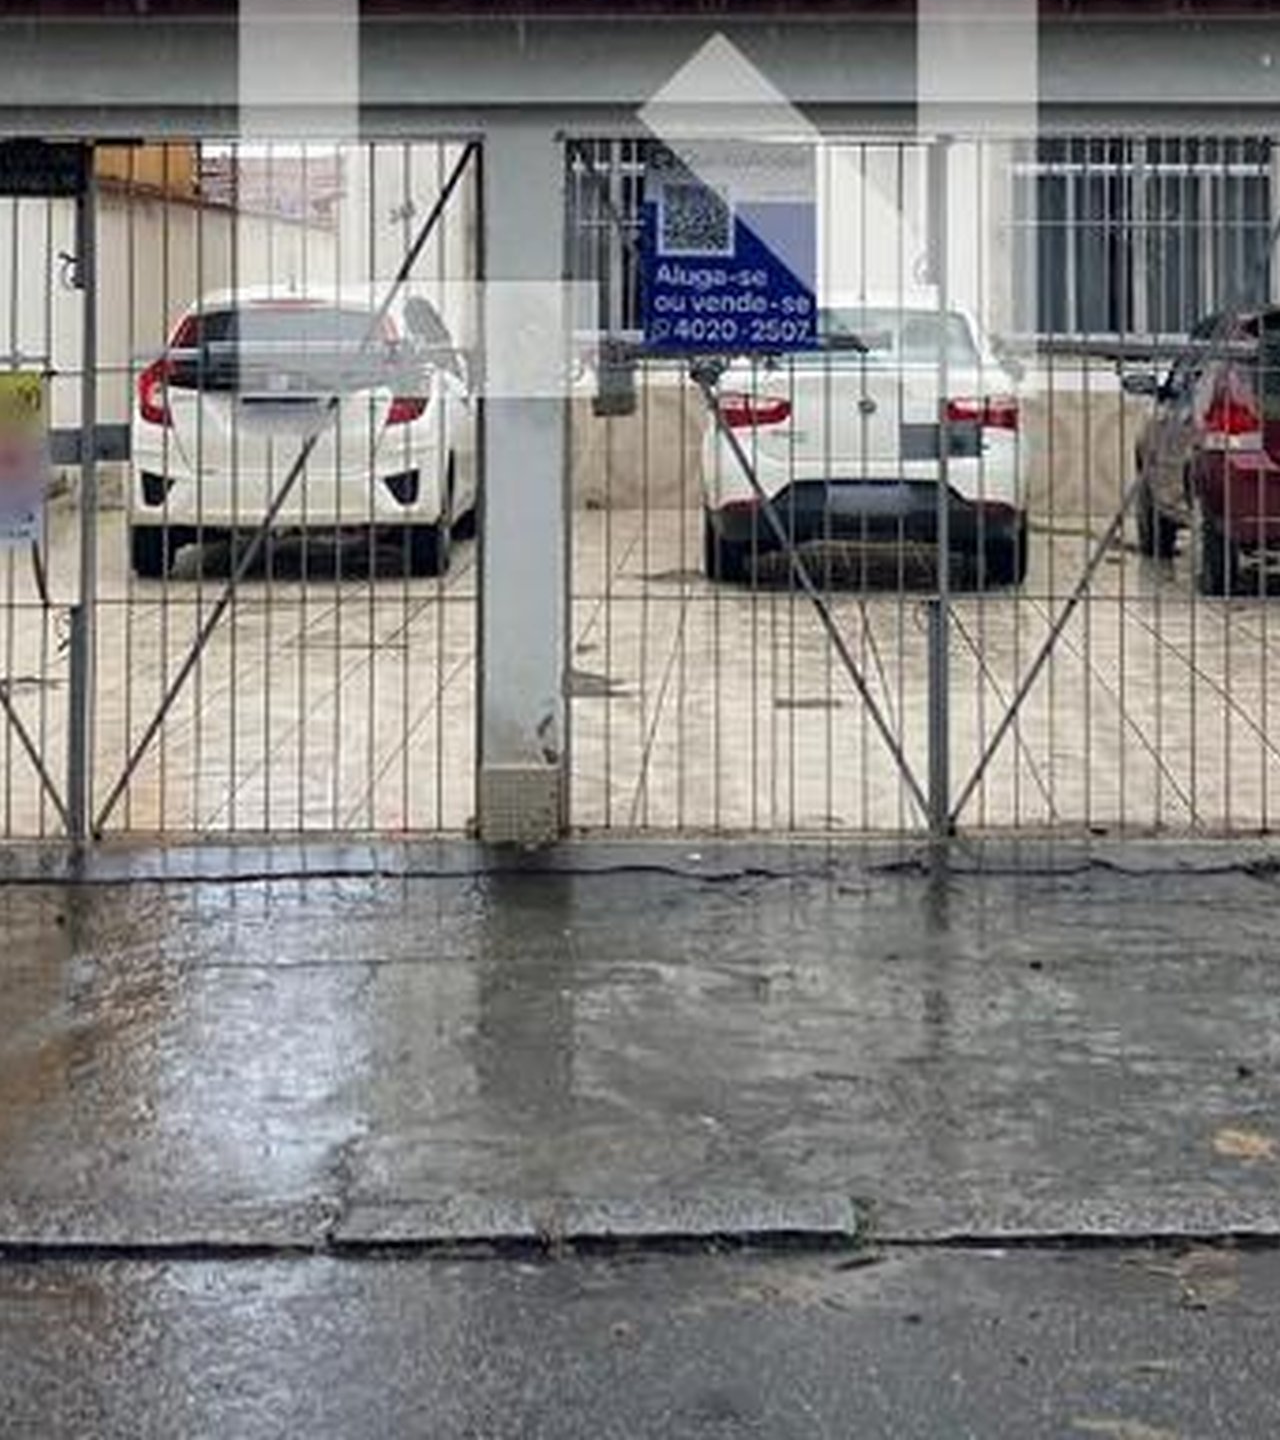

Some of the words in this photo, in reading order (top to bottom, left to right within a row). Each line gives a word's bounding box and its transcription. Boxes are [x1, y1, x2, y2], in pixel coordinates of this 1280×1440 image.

[655, 262, 769, 291] Aluga-se
[653, 294, 686, 312] ou
[691, 292, 811, 315] vende-se
